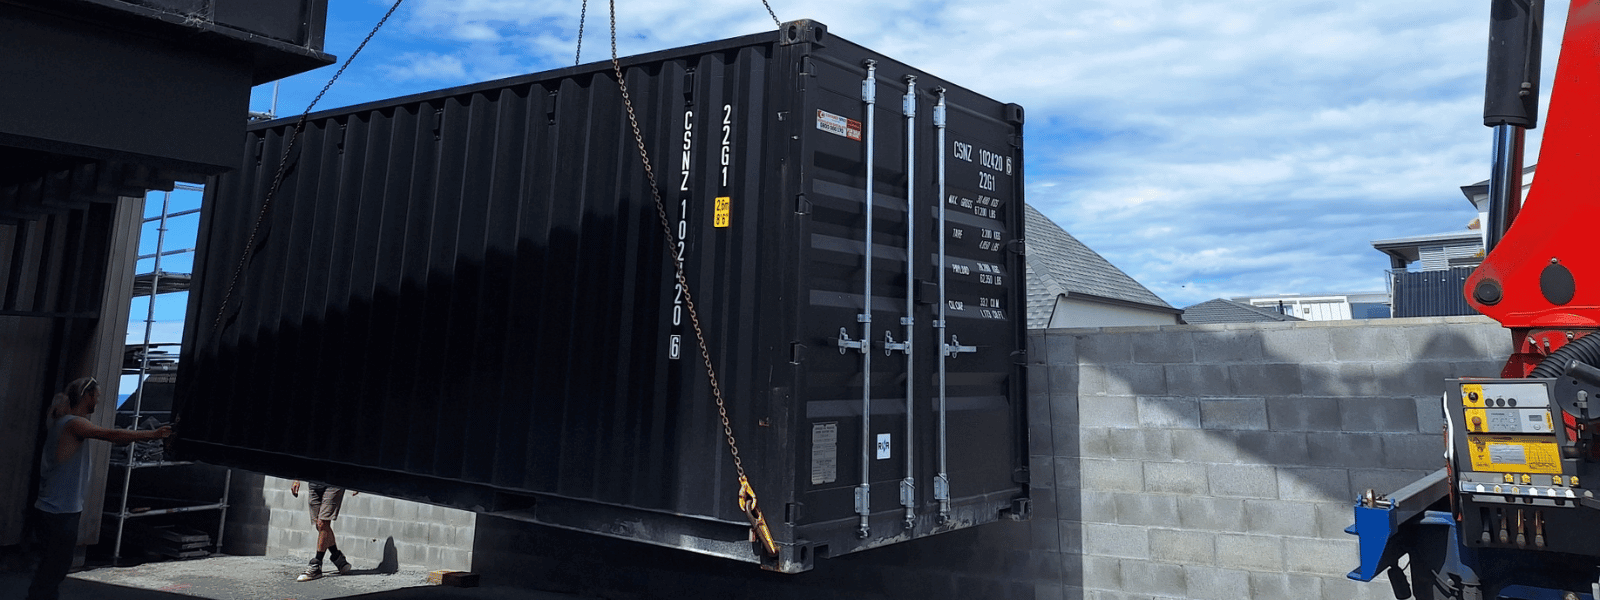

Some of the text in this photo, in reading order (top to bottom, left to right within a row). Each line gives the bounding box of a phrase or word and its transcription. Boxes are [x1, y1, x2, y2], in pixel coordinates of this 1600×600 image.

[722, 104, 732, 187] 22G1
[954, 140, 1012, 175] CSNZ 102420 6
[979, 172, 996, 192] 22G1
[960, 197, 974, 209] GROSS
[670, 111, 692, 358] CSNZ 102420 6
